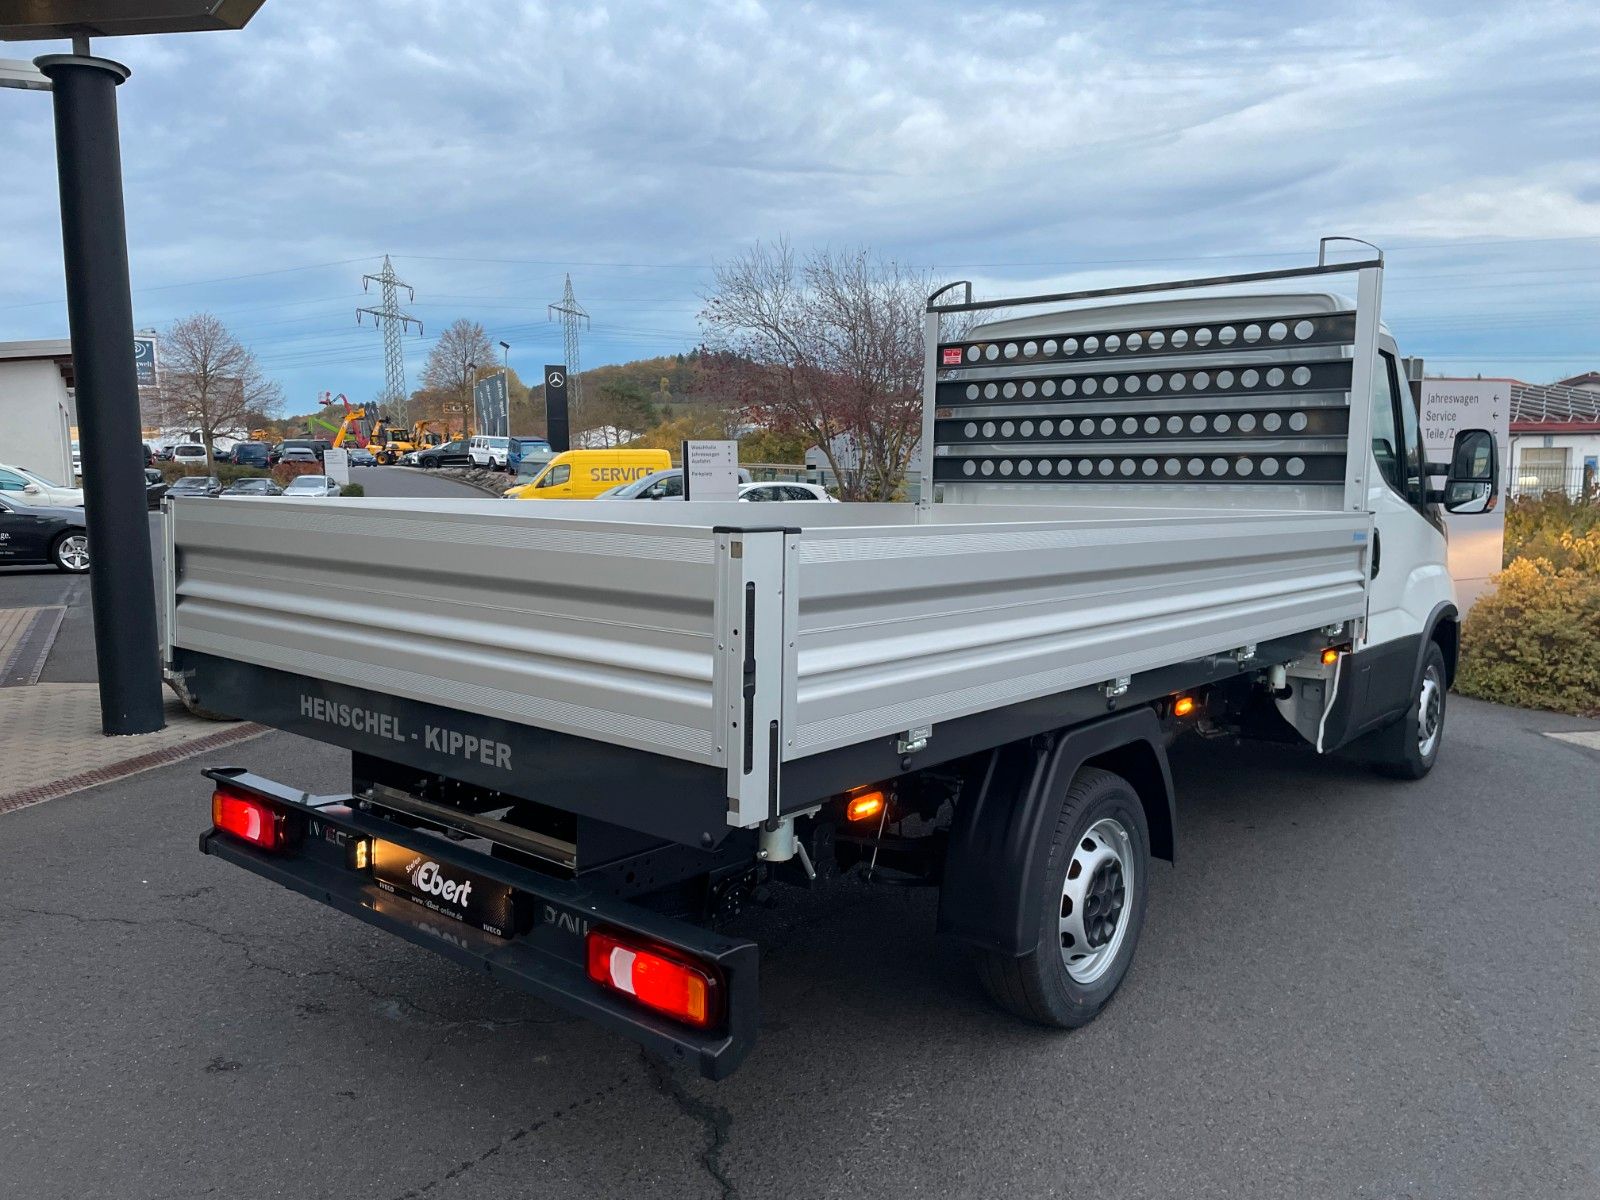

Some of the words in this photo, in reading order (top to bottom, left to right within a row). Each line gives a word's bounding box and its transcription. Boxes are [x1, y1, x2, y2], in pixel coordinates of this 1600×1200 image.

[1426, 393, 1479, 406] Jahreswagen
[1425, 411, 1457, 422] Service
[1425, 428, 1457, 439] Teile/Z
[300, 694, 405, 742] HENSCHEL
[425, 724, 513, 771] KIPPER
[308, 819, 353, 849] IVEC
[379, 882, 395, 893] IVECO
[417, 861, 472, 908] Ebert
[544, 904, 590, 937] DAIL
[483, 923, 502, 936] IVECO
